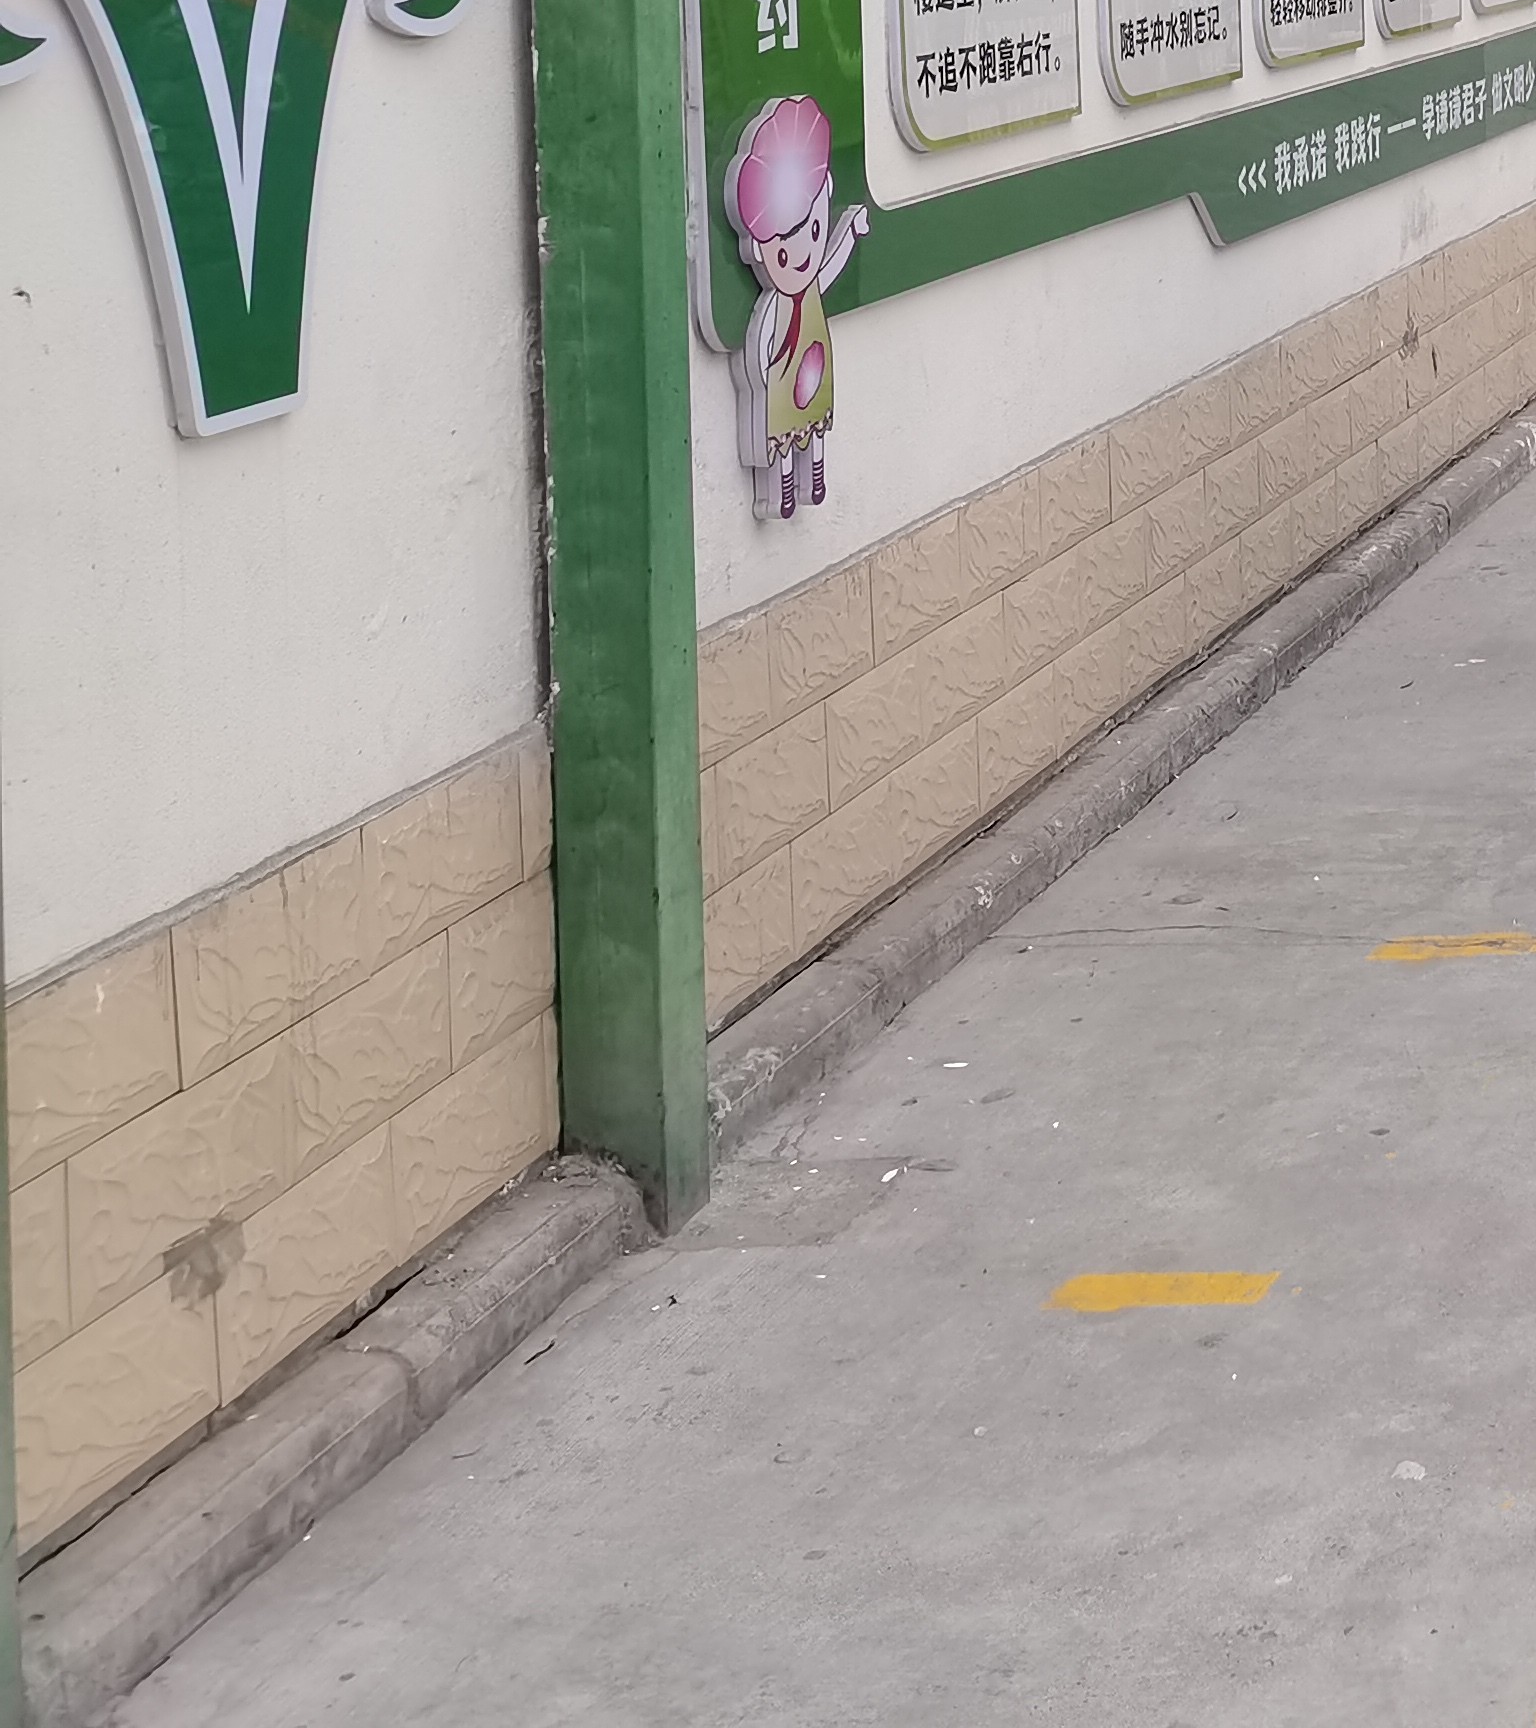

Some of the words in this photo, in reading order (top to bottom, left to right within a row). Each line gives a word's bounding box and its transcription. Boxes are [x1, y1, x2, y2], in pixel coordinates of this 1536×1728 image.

[916, 31, 1061, 99] 不追不跑靠右行。
[1120, 6, 1228, 61] 随手冲水别忘记。
[1274, 128, 1327, 195] 我承诺
[1334, 112, 1381, 173] 我践行
